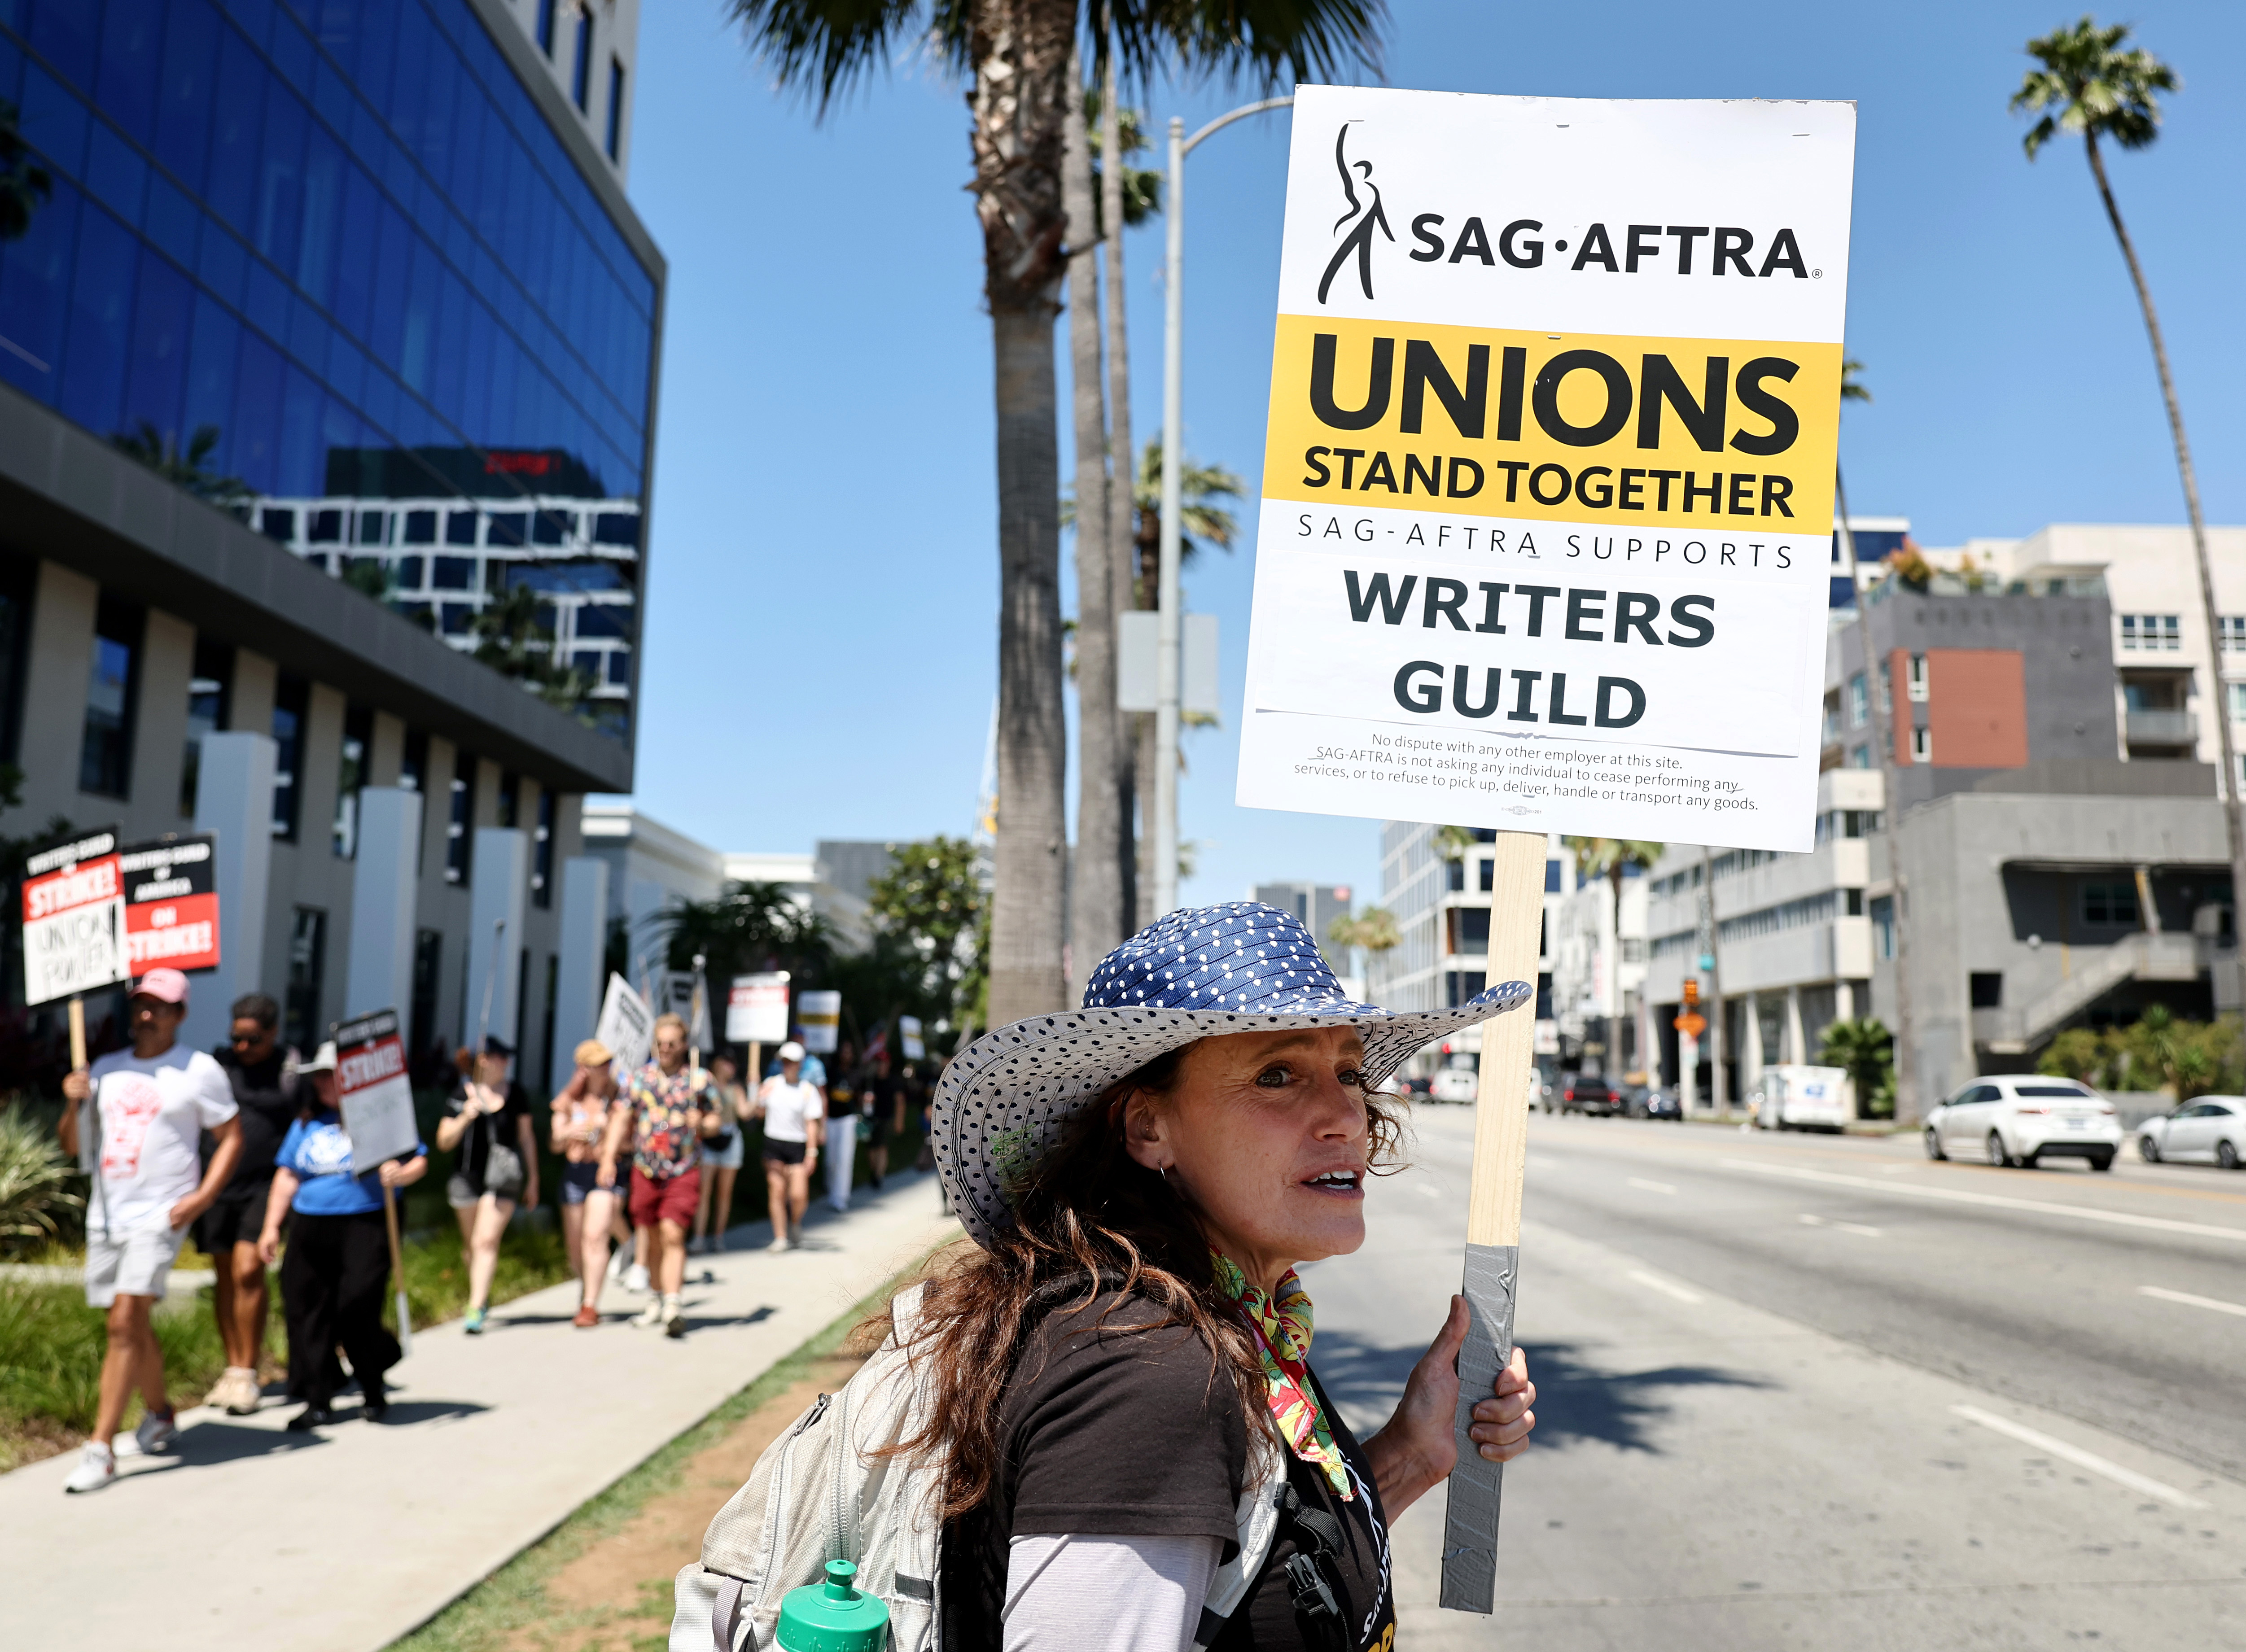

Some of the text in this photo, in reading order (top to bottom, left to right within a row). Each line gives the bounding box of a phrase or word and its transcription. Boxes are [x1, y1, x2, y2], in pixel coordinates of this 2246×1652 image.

[1310, 333, 1800, 456] UNIONS
[1302, 446, 1795, 518] STAND TOGETHER
[1298, 514, 1791, 568] SAG-AFTRA SUPPORTS
[1344, 570, 1715, 648] WRITERS
[1394, 660, 1646, 728] GUILD
[1317, 746, 1738, 794] SAG-AFTRA is not asking any individual to cease performing any
[1372, 734, 1682, 769] No dispute with any other employer at this site.
[1295, 764, 1758, 811] services, or to refuse to pick up, deliver, handle or transport any goods.
[28, 861, 118, 918] STRIKE!
